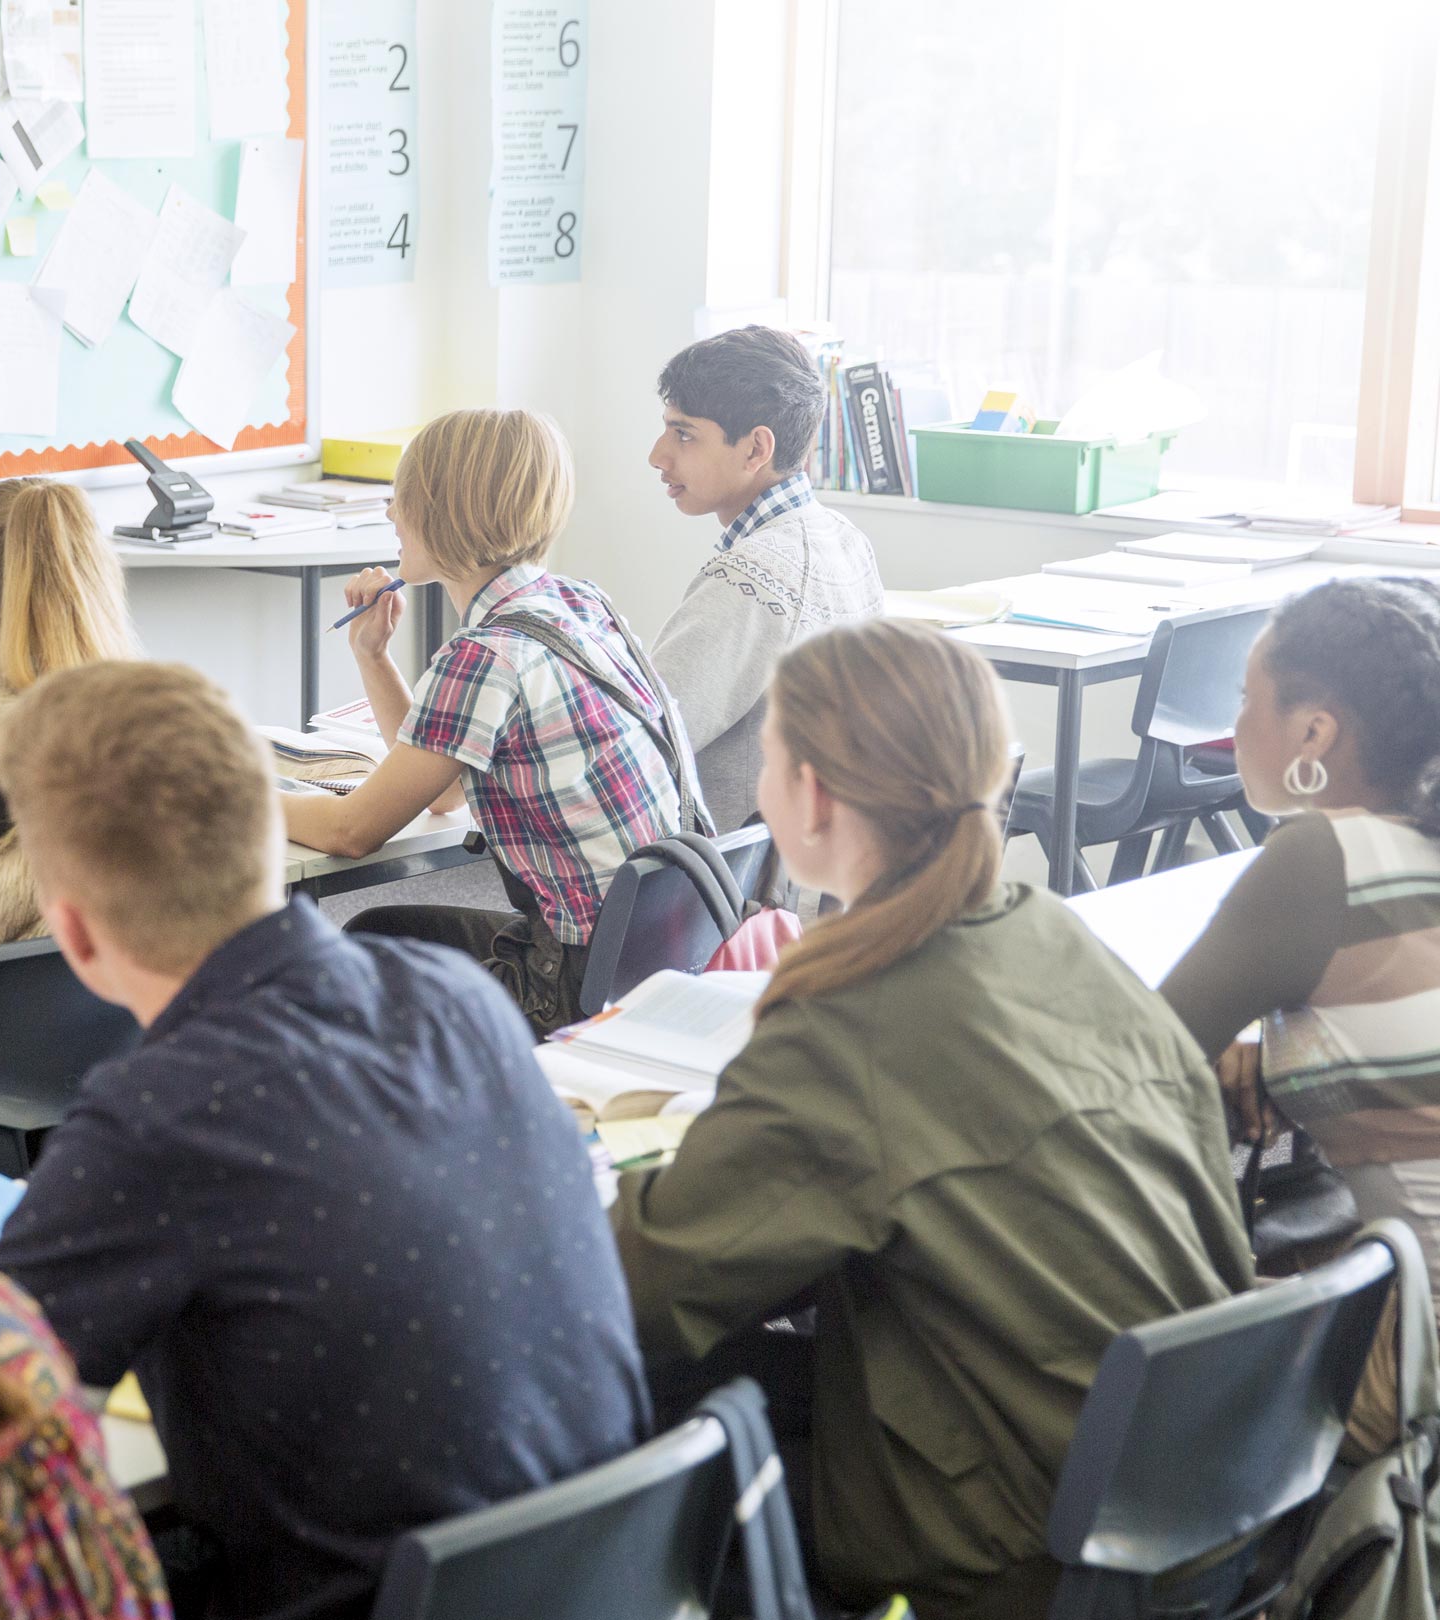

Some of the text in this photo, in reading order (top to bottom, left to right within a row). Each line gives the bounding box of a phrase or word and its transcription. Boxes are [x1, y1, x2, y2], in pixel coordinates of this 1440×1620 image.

[388, 42, 410, 91] 2
[558, 18, 581, 70] 6
[388, 127, 410, 176] 3
[557, 123, 579, 172] 7
[386, 211, 411, 260] 4
[554, 211, 577, 258] 8
[860, 387, 886, 471] German
